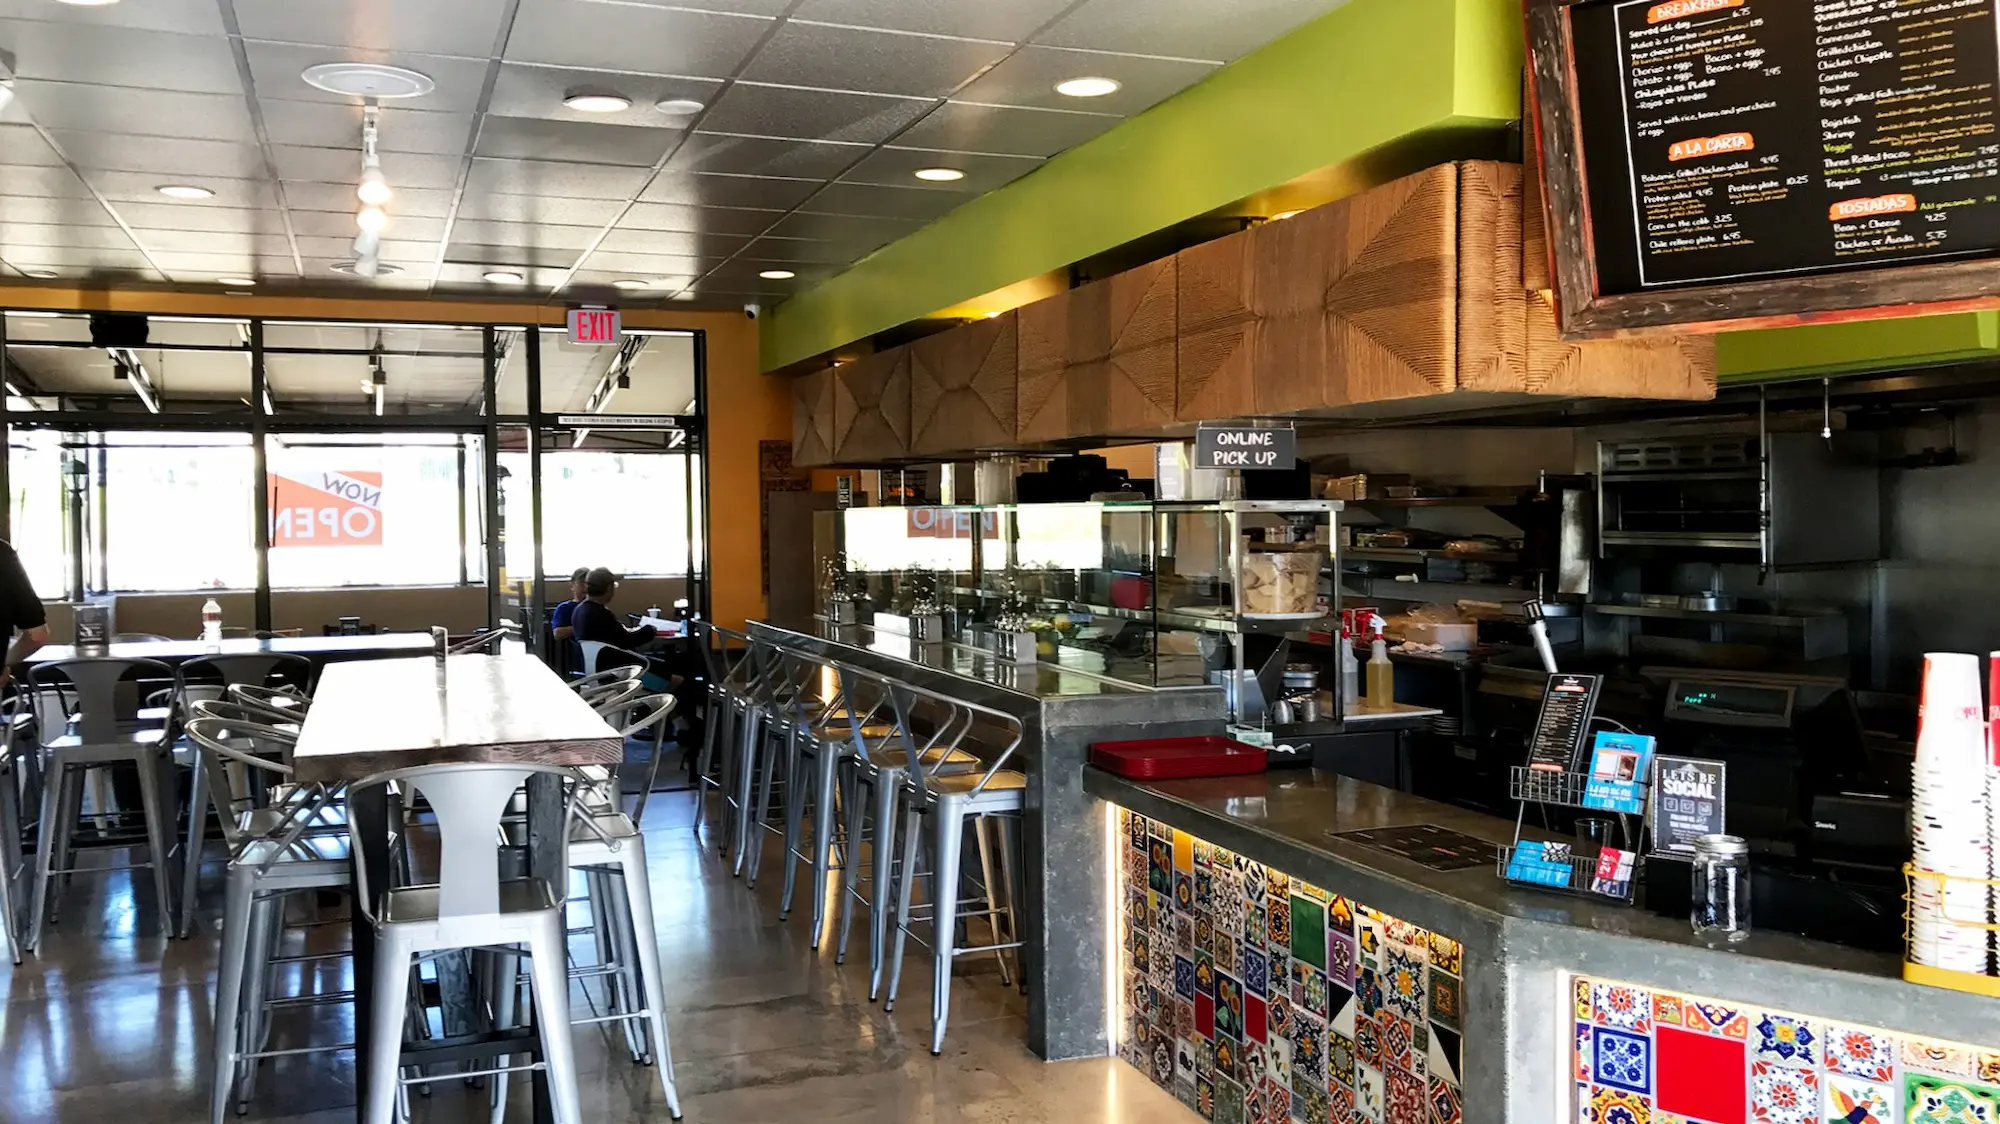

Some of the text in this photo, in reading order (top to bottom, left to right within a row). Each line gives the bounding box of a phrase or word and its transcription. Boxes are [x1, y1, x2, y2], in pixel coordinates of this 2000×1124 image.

[1629, 26, 1659, 38] Served
[1674, 22, 1691, 30] day
[1816, 24, 1833, 33] Your
[1834, 21, 1859, 30] choice
[1670, 32, 1697, 42] Combo
[1631, 52, 1648, 61] Your
[1649, 47, 1674, 57] choice
[1674, 44, 1684, 52] of
[1849, 40, 1883, 52] chicken
[1704, 54, 1733, 64] Bacon
[1743, 48, 1765, 58] eggs
[1817, 51, 1894, 70] Chicken Chipotle
[1632, 65, 1664, 78] Chorizo
[1673, 62, 1693, 72] eggs
[1705, 64, 1733, 74] Beans
[1742, 59, 1764, 70] eggs
[1633, 76, 1663, 88] Potato
[1673, 71, 1694, 82] eggs
[1818, 71, 1860, 83] Carnitas
[1634, 85, 1686, 99] Chilaquiles
[1677, 91, 1708, 103] Verdes
[1819, 84, 1851, 95] Pastor
[1845, 91, 1875, 106] grilled
[1637, 119, 1662, 129] Served
[1664, 115, 1681, 124] with
[1751, 100, 1777, 111] choice
[1638, 128, 1664, 137] of eggs
[1822, 130, 1856, 141] Shrimp
[1673, 135, 1746, 157] A LA CARTA
[1823, 142, 1853, 153] Veggie
[1823, 158, 1850, 168] Three
[1851, 152, 1881, 164] Rolled
[1882, 151, 1911, 160] tacos
[1641, 173, 1676, 182] Balsamic
[1727, 161, 1749, 172] salad
[1728, 183, 1758, 193] Protein
[1758, 180, 1780, 190] plate
[1786, 175, 1809, 186] 10.25
[1644, 195, 1671, 204] Protein
[1672, 192, 1692, 200] salad
[1838, 197, 1906, 215] TOSTADAS
[1648, 222, 1666, 231] Corn
[1714, 214, 1733, 224] 3.25
[1833, 223, 1858, 233] Bean
[1868, 219, 1902, 229] Cheese
[1649, 240, 1668, 249] Chile
[1669, 237, 1695, 247] relleno
[1695, 235, 1716, 246] plate
[1722, 231, 1742, 241] 6.95
[1834, 239, 1870, 250] Chicken
[1871, 238, 1882, 246] or
[1884, 234, 1915, 245] Asada
[1926, 230, 1947, 240] 5.75
[577, 312, 614, 341] EXIT
[1217, 432, 1274, 446] ONLINE
[1213, 450, 1277, 466] PICK UP
[1662, 768, 1716, 784] LETS BE
[1662, 779, 1716, 800] SOCIAL
